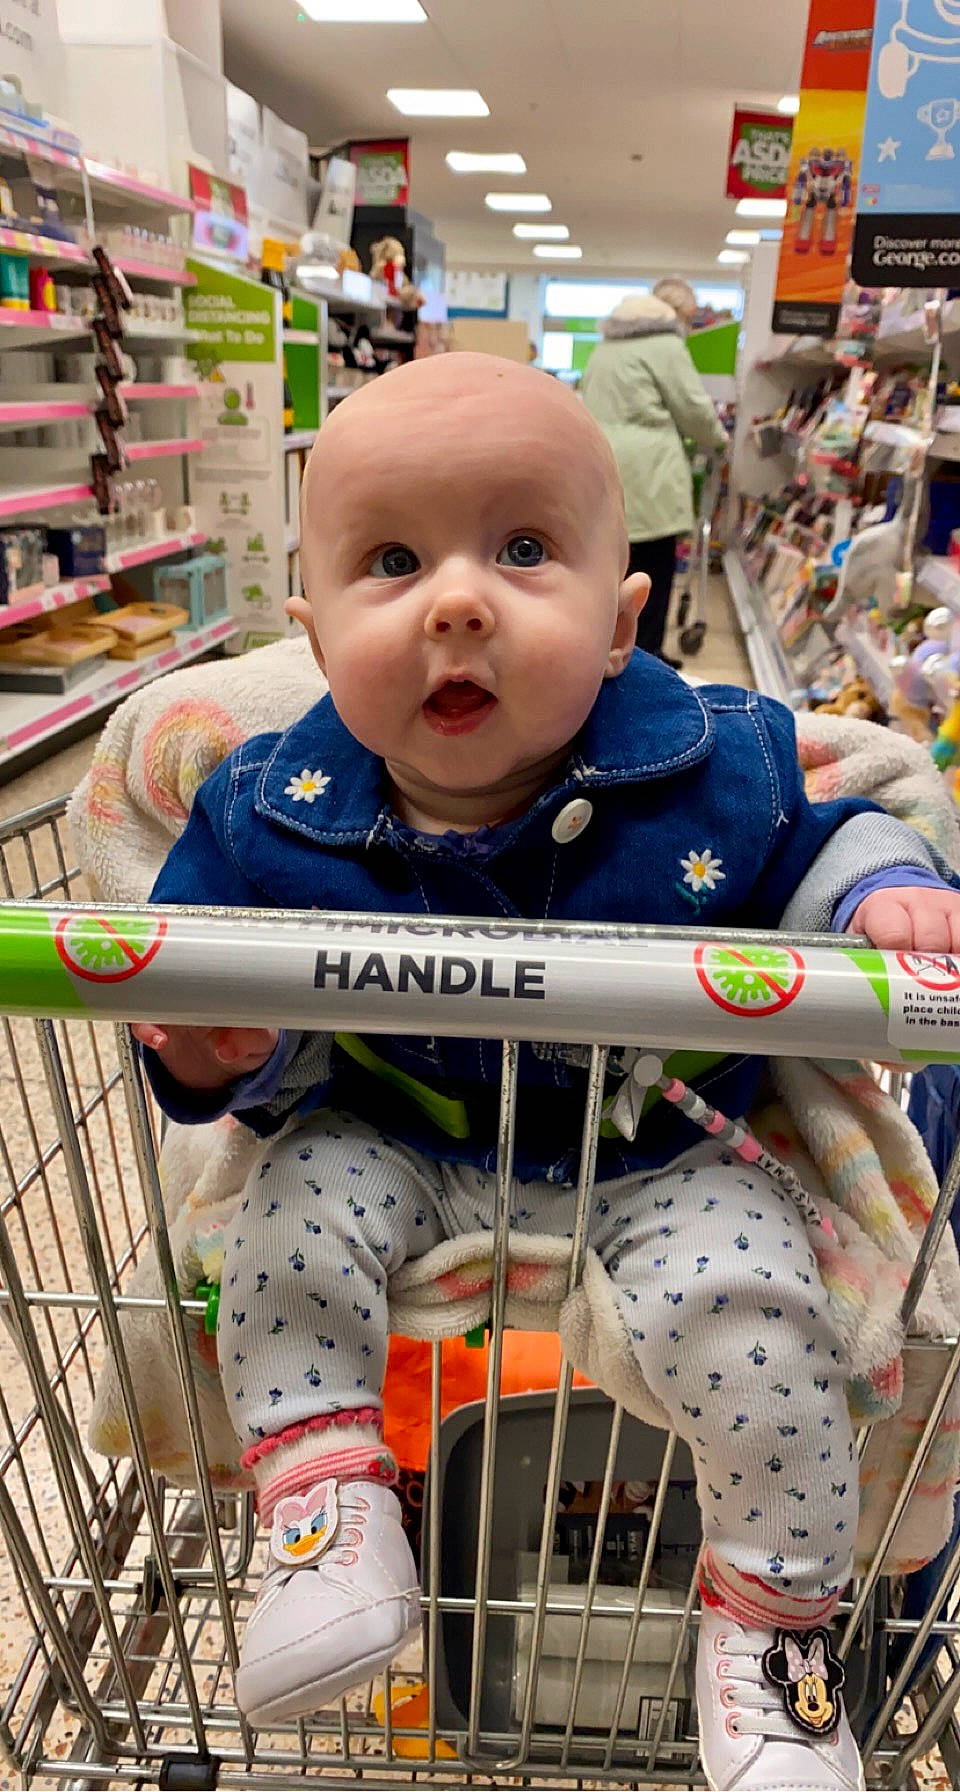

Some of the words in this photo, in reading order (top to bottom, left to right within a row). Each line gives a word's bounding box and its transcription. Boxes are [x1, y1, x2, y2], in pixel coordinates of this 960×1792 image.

[873, 235, 926, 249] Discover
[930, 239, 960, 250] more
[313, 949, 546, 999] HANDLE
[904, 991, 912, 1001] It
[929, 993, 960, 1002] unsaf
[903, 1004, 933, 1014] place
[919, 1016, 937, 1026] the
